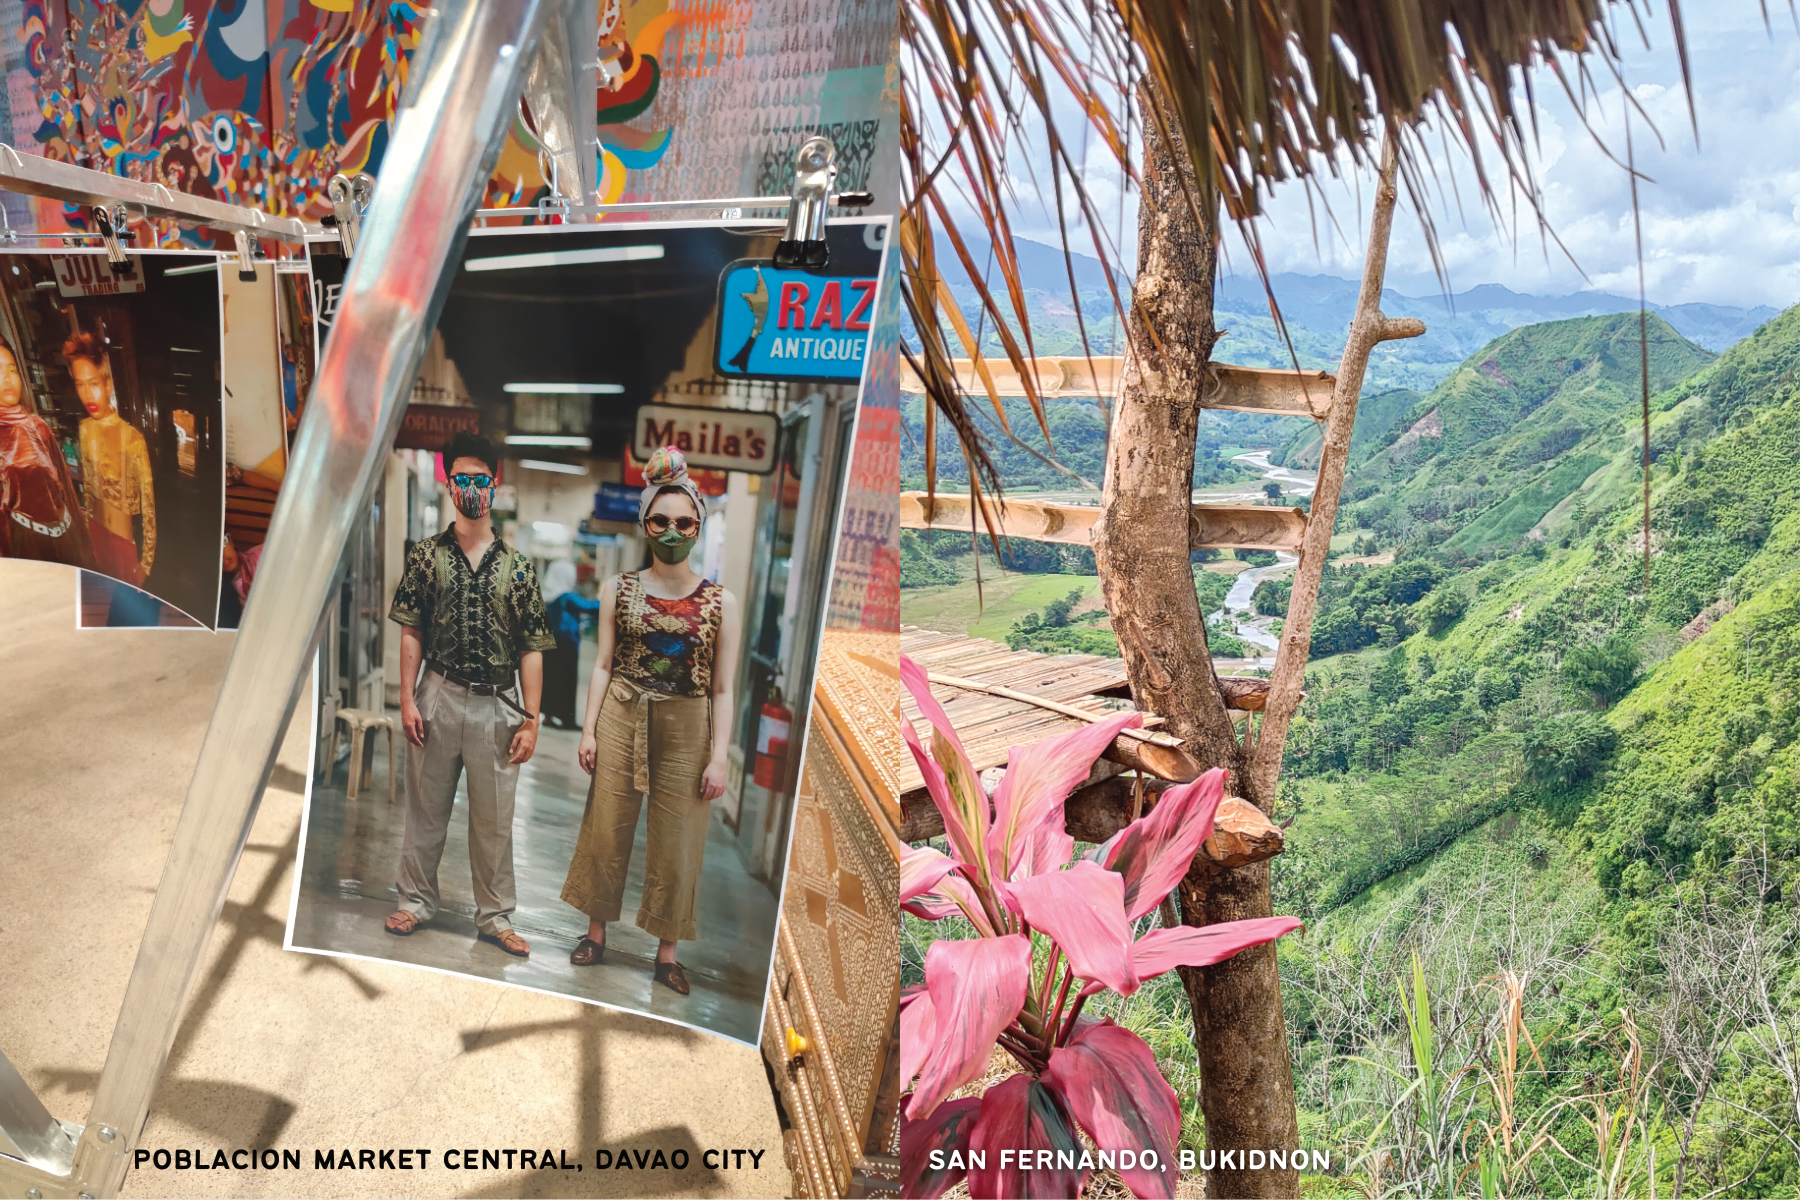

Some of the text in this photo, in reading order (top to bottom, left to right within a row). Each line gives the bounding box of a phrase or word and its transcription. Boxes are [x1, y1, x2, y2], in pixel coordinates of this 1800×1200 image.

[61, 254, 138, 287] JUL
[81, 282, 120, 296] TRADING
[769, 337, 866, 361] ANTIQUE
[643, 417, 767, 461] Maila's
